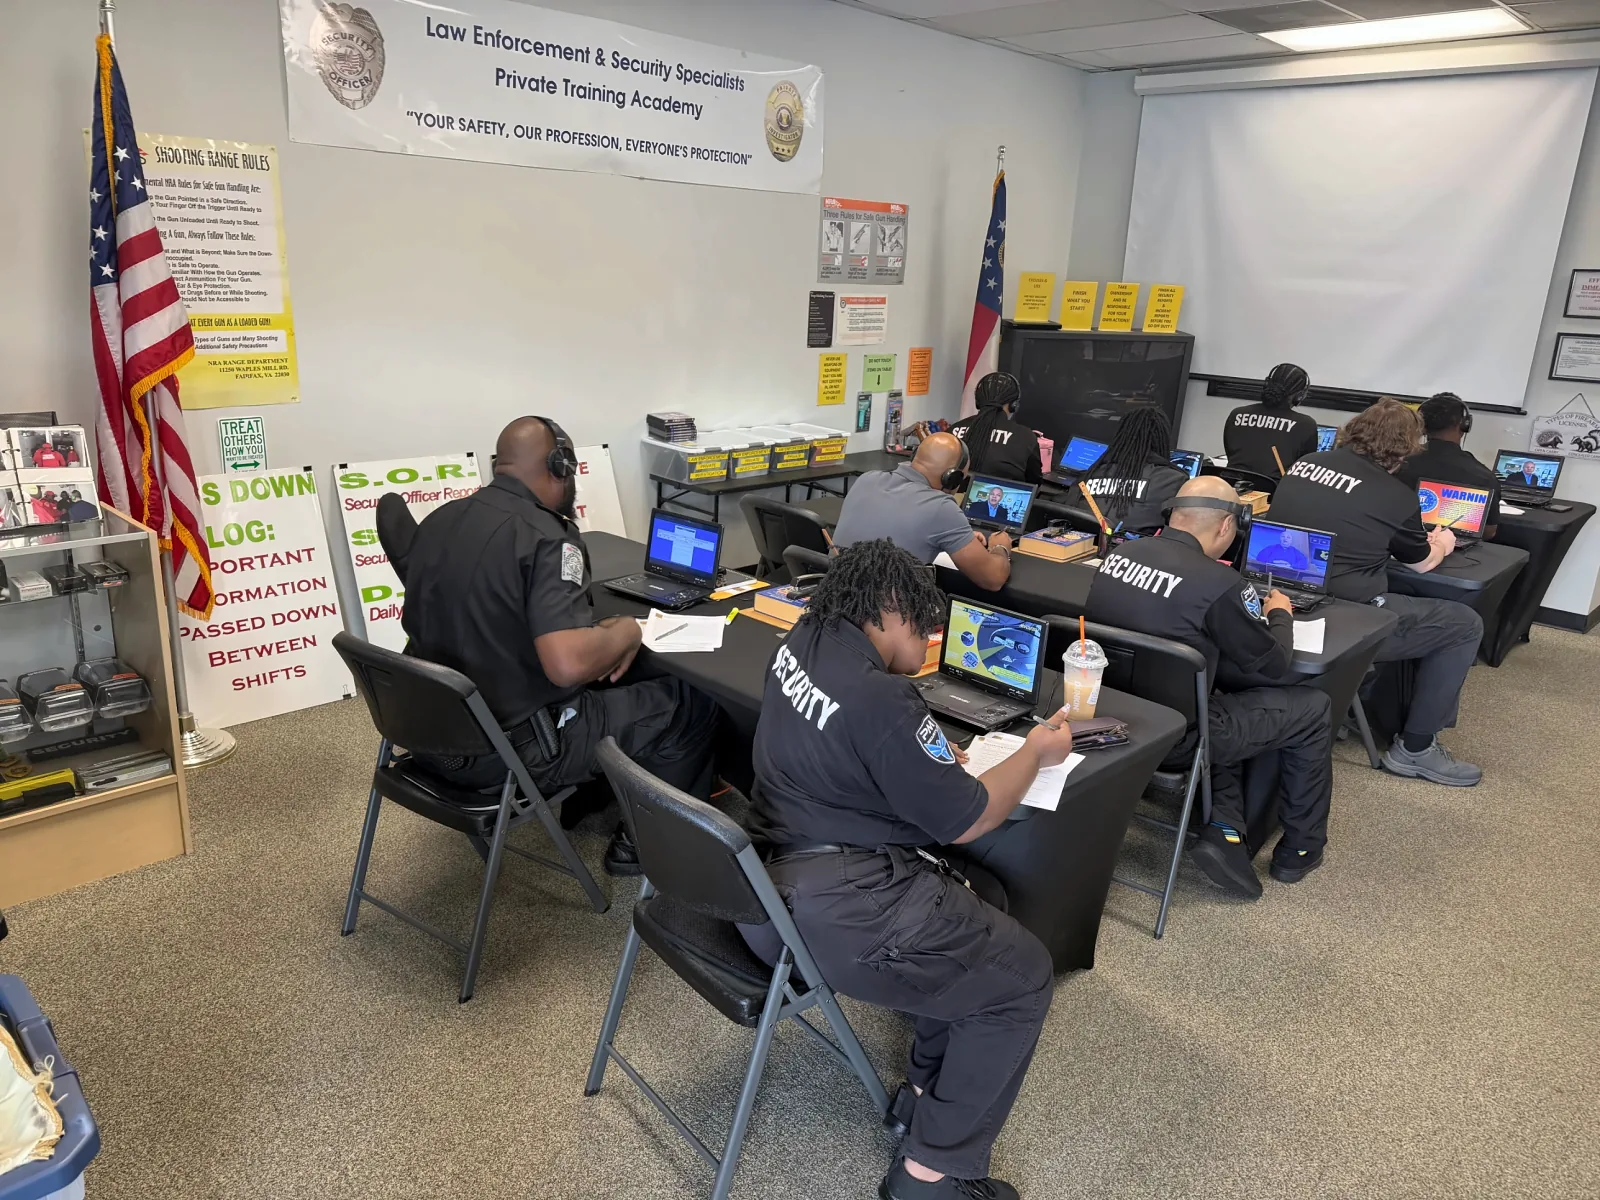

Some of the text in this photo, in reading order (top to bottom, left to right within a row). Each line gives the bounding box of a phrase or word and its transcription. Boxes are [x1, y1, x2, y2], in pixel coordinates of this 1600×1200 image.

[322, 32, 376, 52] SECURITY
[426, 16, 744, 92] Law Enforcement & Security Specialists
[329, 71, 372, 88] OFFICER
[496, 67, 703, 120] Private Training Academy
[459, 118, 509, 138] SAFETY,
[514, 125, 541, 140] OUR
[546, 129, 622, 151] PROFESSION,
[626, 138, 688, 158] EVERYONE’S
[156, 146, 205, 166] SHOOTING
[207, 151, 240, 169] RANGE
[242, 153, 270, 171] RULES
[165, 179, 249, 194] NRA Rules for Safe Gun Handling
[824, 210, 839, 218] Three
[841, 211, 854, 219] Rules
[887, 216, 905, 226] Handling
[188, 230, 205, 241] Always
[207, 231, 223, 240] Follow
[225, 232, 239, 240] These
[198, 318, 213, 327] EVERY
[215, 318, 225, 327] GUN
[239, 318, 258, 326] LOADED
[222, 420, 260, 435] TREAT
[1235, 413, 1297, 432] SECURITY
[1546, 415, 1564, 424] TYPES
[224, 434, 262, 446] OTHERS
[952, 427, 1012, 444] SEITY
[225, 445, 263, 456] HOW YOU
[339, 464, 476, 489] S.O.R.
[1287, 461, 1362, 494] SECURITY
[230, 473, 316, 503] DOWN
[400, 490, 441, 504] Officer
[1083, 478, 1146, 498] SECUY
[1442, 488, 1486, 503] WARNIN
[206, 520, 275, 548] LOG:
[1100, 554, 1183, 598] SECURITY
[180, 603, 336, 642] PASSED DOWN
[370, 604, 404, 622] Daily
[232, 664, 306, 691] SHIFTS
[772, 644, 840, 731] SECURITY
[920, 720, 935, 740] PM
[31, 729, 130, 755] SECURITY
